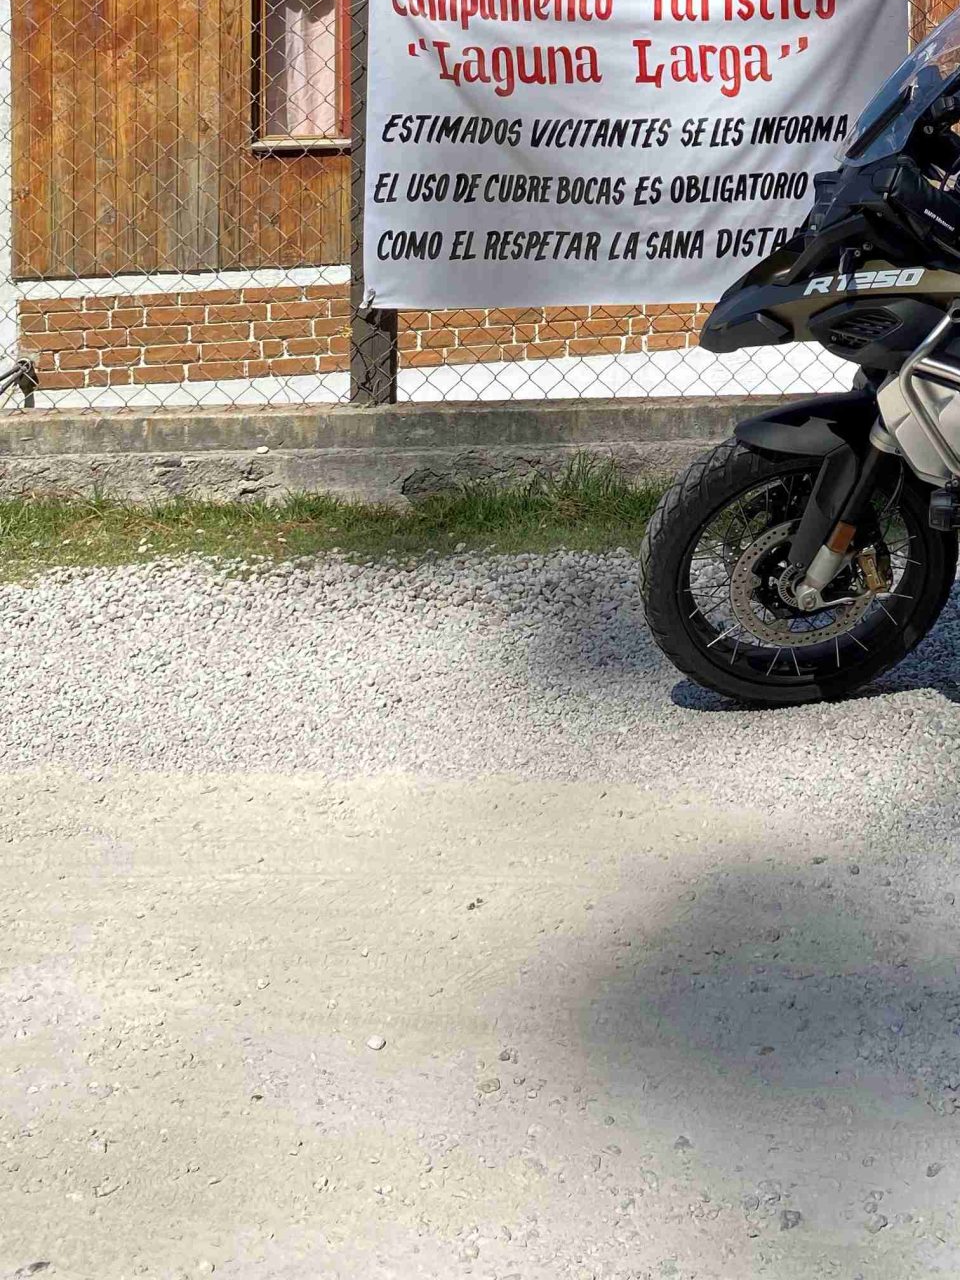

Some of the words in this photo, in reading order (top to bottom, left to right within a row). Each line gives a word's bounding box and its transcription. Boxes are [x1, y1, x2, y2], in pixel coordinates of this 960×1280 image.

[381, 113, 523, 147] ESTIMADOS
[530, 117, 672, 149] VICITANTES
[680, 117, 709, 147] SE
[709, 117, 745, 148] LES
[750, 113, 849, 145] INFORMA
[373, 173, 399, 203] EL
[406, 173, 450, 202] USO
[452, 173, 482, 203] DE
[483, 173, 553, 203] CUBRE
[556, 176, 627, 206] BOCAS
[633, 175, 663, 206] ES
[670, 171, 809, 203] OBLIGATORIO
[376, 230, 443, 261] COMO
[449, 230, 477, 261] EL
[483, 230, 602, 261] RESPETAR
[608, 231, 640, 261] LA
[645, 229, 705, 261] SANA
[802, 276, 834, 296] R
[836, 268, 925, 292] 1250
